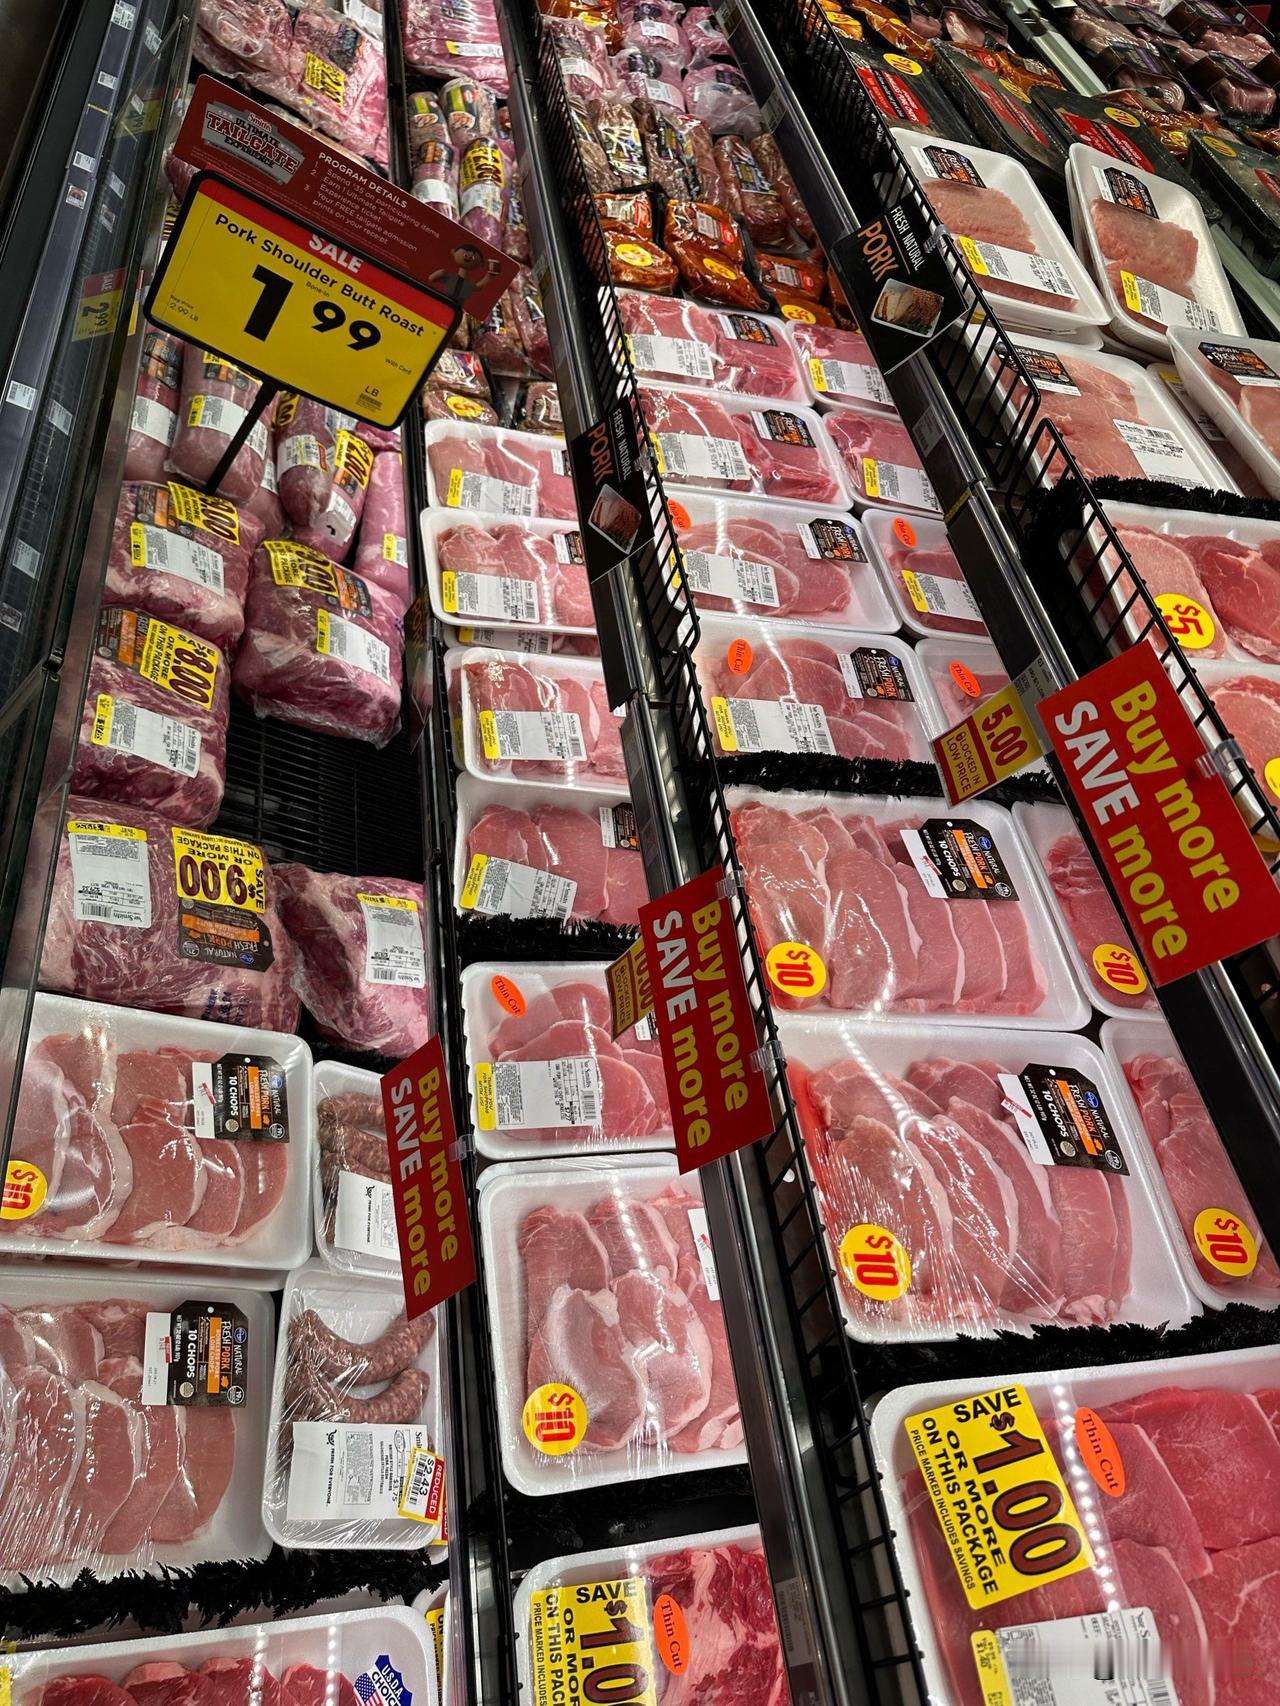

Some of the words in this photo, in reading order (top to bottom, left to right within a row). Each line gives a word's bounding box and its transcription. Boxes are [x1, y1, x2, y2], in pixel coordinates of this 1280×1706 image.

[207, 111, 300, 175] TAILGATE
[224, 136, 275, 168] EXPERIENCE
[236, 118, 281, 148] ULTIMATE
[319, 152, 367, 184] PROGRAM
[368, 181, 408, 208] DETAILS
[317, 192, 334, 205] Your
[334, 201, 355, 217] FREE
[355, 212, 383, 234] tailgate
[383, 228, 418, 252] admission
[320, 183, 361, 211] Experience
[361, 206, 381, 223] ticket
[323, 177, 341, 190] Earn
[346, 188, 378, 212] Ultimate
[380, 208, 405, 228] Tailgate
[327, 169, 351, 187] Spend
[365, 192, 376, 200] on
[376, 195, 421, 228] participating
[421, 223, 440, 239] items
[312, 199, 335, 216] prints
[335, 211, 346, 222] on
[346, 218, 362, 231] your
[362, 228, 389, 246] receipt
[890, 205, 911, 234] FRESH
[902, 232, 925, 272] NATURAL
[309, 234, 363, 274] SALE
[857, 221, 899, 282] PORK
[215, 213, 257, 245] Pork
[261, 239, 338, 288] Shoulder
[340, 283, 377, 311] Butt
[379, 304, 424, 337] Roast
[169, 302, 189, 316] 2.99
[189, 313, 199, 322] LB
[243, 264, 294, 342] 1
[311, 300, 382, 351] 99
[364, 385, 380, 398] LB
[612, 408, 626, 439] FRESH
[587, 422, 614, 486] PORK
[617, 438, 633, 481] NATURAL
[159, 624, 168, 635] ON
[1163, 602, 1205, 639] $5
[156, 635, 166, 651] THIS
[165, 636, 176, 650] OR
[177, 632, 215, 657] SAVE
[150, 650, 162, 682] PACKAGE
[161, 651, 173, 680] MORE
[168, 646, 215, 704] $8.00
[883, 677, 898, 698] PORK
[981, 703, 1028, 767] 5.00
[946, 736, 960, 761] LOW
[955, 762, 972, 793] PRICE
[972, 774, 981, 785] IN
[1110, 680, 1178, 774] Buy
[1154, 778, 1240, 913] more
[177, 835, 221, 852] PACKAGE
[938, 839, 949, 850] 10
[1054, 700, 1140, 825] SAVE
[1107, 824, 1188, 960] more
[187, 847, 229, 861] MORE
[223, 845, 245, 858] THIS
[234, 857, 253, 866] OR
[246, 852, 260, 861] ON
[943, 849, 961, 877] CHOPS
[964, 832, 980, 854] FRESH
[973, 851, 988, 871] PORK
[179, 854, 256, 906] $9.00
[255, 868, 265, 910] SAVE
[692, 900, 727, 981] Buy
[615, 967, 623, 994] LOW
[653, 910, 698, 1022] SAVE
[776, 949, 815, 988] $10
[1103, 950, 1140, 986] $10
[495, 976, 509, 998] Thin
[508, 998, 520, 1014] Cut
[708, 988, 748, 1112] more
[229, 1075, 238, 1086] 10
[258, 1068, 271, 1091] FRESH
[672, 1025, 711, 1149] more
[229, 1087, 239, 1116] CHOPS
[260, 1090, 270, 1111] PORK
[418, 1066, 443, 1143] Buy
[1042, 1090, 1053, 1101] 10
[1048, 1103, 1070, 1137] CHOPS
[1068, 1084, 1086, 1109] FRESH
[1080, 1108, 1097, 1133] PORK
[391, 1077, 423, 1181] SAVE
[1090, 1109, 1110, 1139] NATURAL
[430, 1150, 458, 1262] more
[403, 1183, 431, 1297] more
[1205, 1217, 1249, 1264] $10
[853, 1234, 899, 1287] $10
[188, 1329, 198, 1341] 10
[221, 1320, 232, 1344] FRESH
[186, 1342, 197, 1378] CHOPS
[221, 1345, 231, 1370] PORK
[233, 1344, 243, 1376] NATURAL
[534, 1392, 576, 1443] $10
[953, 1387, 1022, 1424] SAVE
[1082, 1413, 1102, 1455] Thin
[1099, 1458, 1119, 1490] Cut
[392, 1478, 400, 1502] $3.75
[418, 1457, 435, 1496] $2.43
[429, 1464, 444, 1514] REDUCED
[973, 1411, 1082, 1576] $1.00
[911, 1429, 927, 1456] PRICE
[921, 1457, 942, 1497] MARKED
[936, 1497, 960, 1546] INCLUDES
[954, 1546, 976, 1590] SAVINGS
[922, 1417, 943, 1445] ON
[935, 1448, 961, 1494] THIS
[953, 1498, 999, 1596] PACKAGE
[946, 1429, 968, 1471] OR
[964, 1478, 1007, 1568] MORE
[546, 1592, 559, 1619] ON
[576, 1581, 636, 1604] SAVE
[533, 1602, 543, 1623] PRICE
[563, 1607, 576, 1645] OR
[535, 1627, 545, 1663] MARKED
[547, 1622, 563, 1665] THIS
[580, 1599, 650, 1706] $1.0
[661, 1600, 676, 1638] Thin
[669, 1639, 683, 1669] Cut
[381, 1664, 404, 1700] U.S.D.A.
[537, 1664, 548, 1706] INCLUDES
[551, 1668, 566, 1706] PAC
